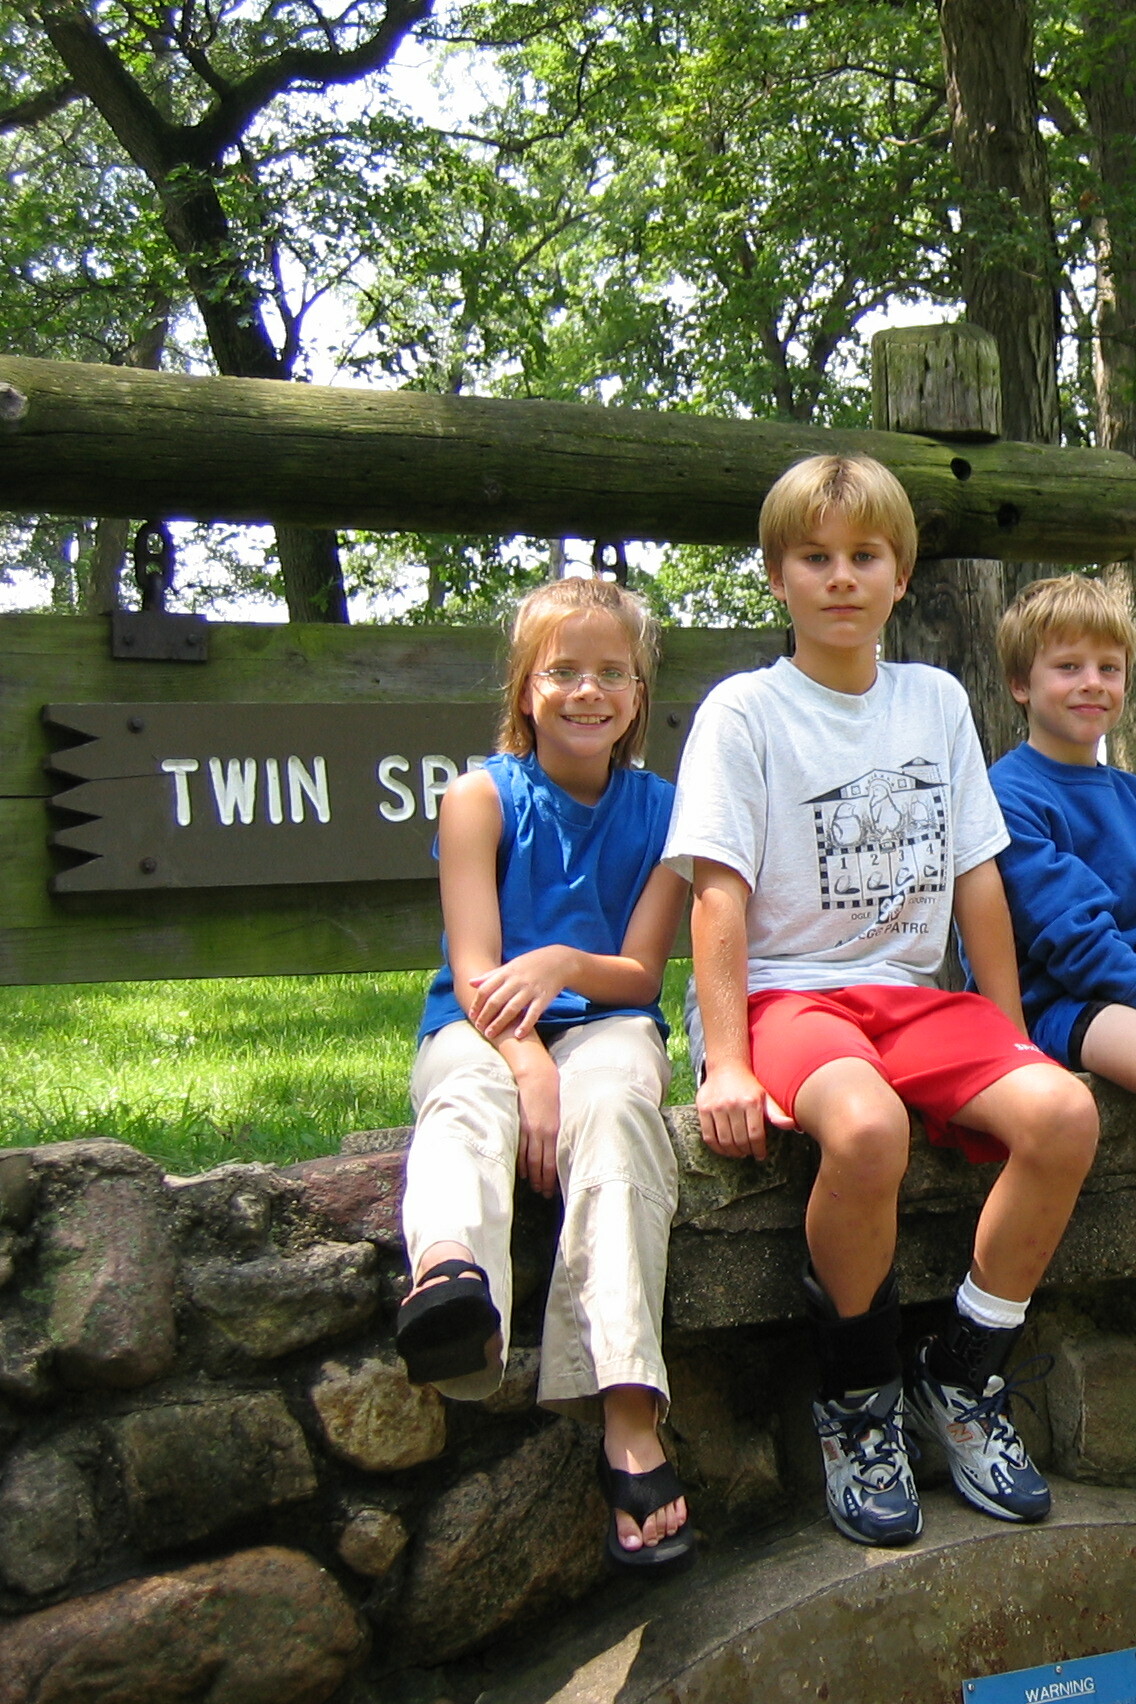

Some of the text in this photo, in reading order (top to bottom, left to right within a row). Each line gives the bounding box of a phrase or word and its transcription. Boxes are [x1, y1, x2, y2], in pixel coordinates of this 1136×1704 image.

[161, 754, 487, 826] TWIN SP
[870, 853, 880, 866] 2
[1024, 1676, 1096, 1703] WARNING
